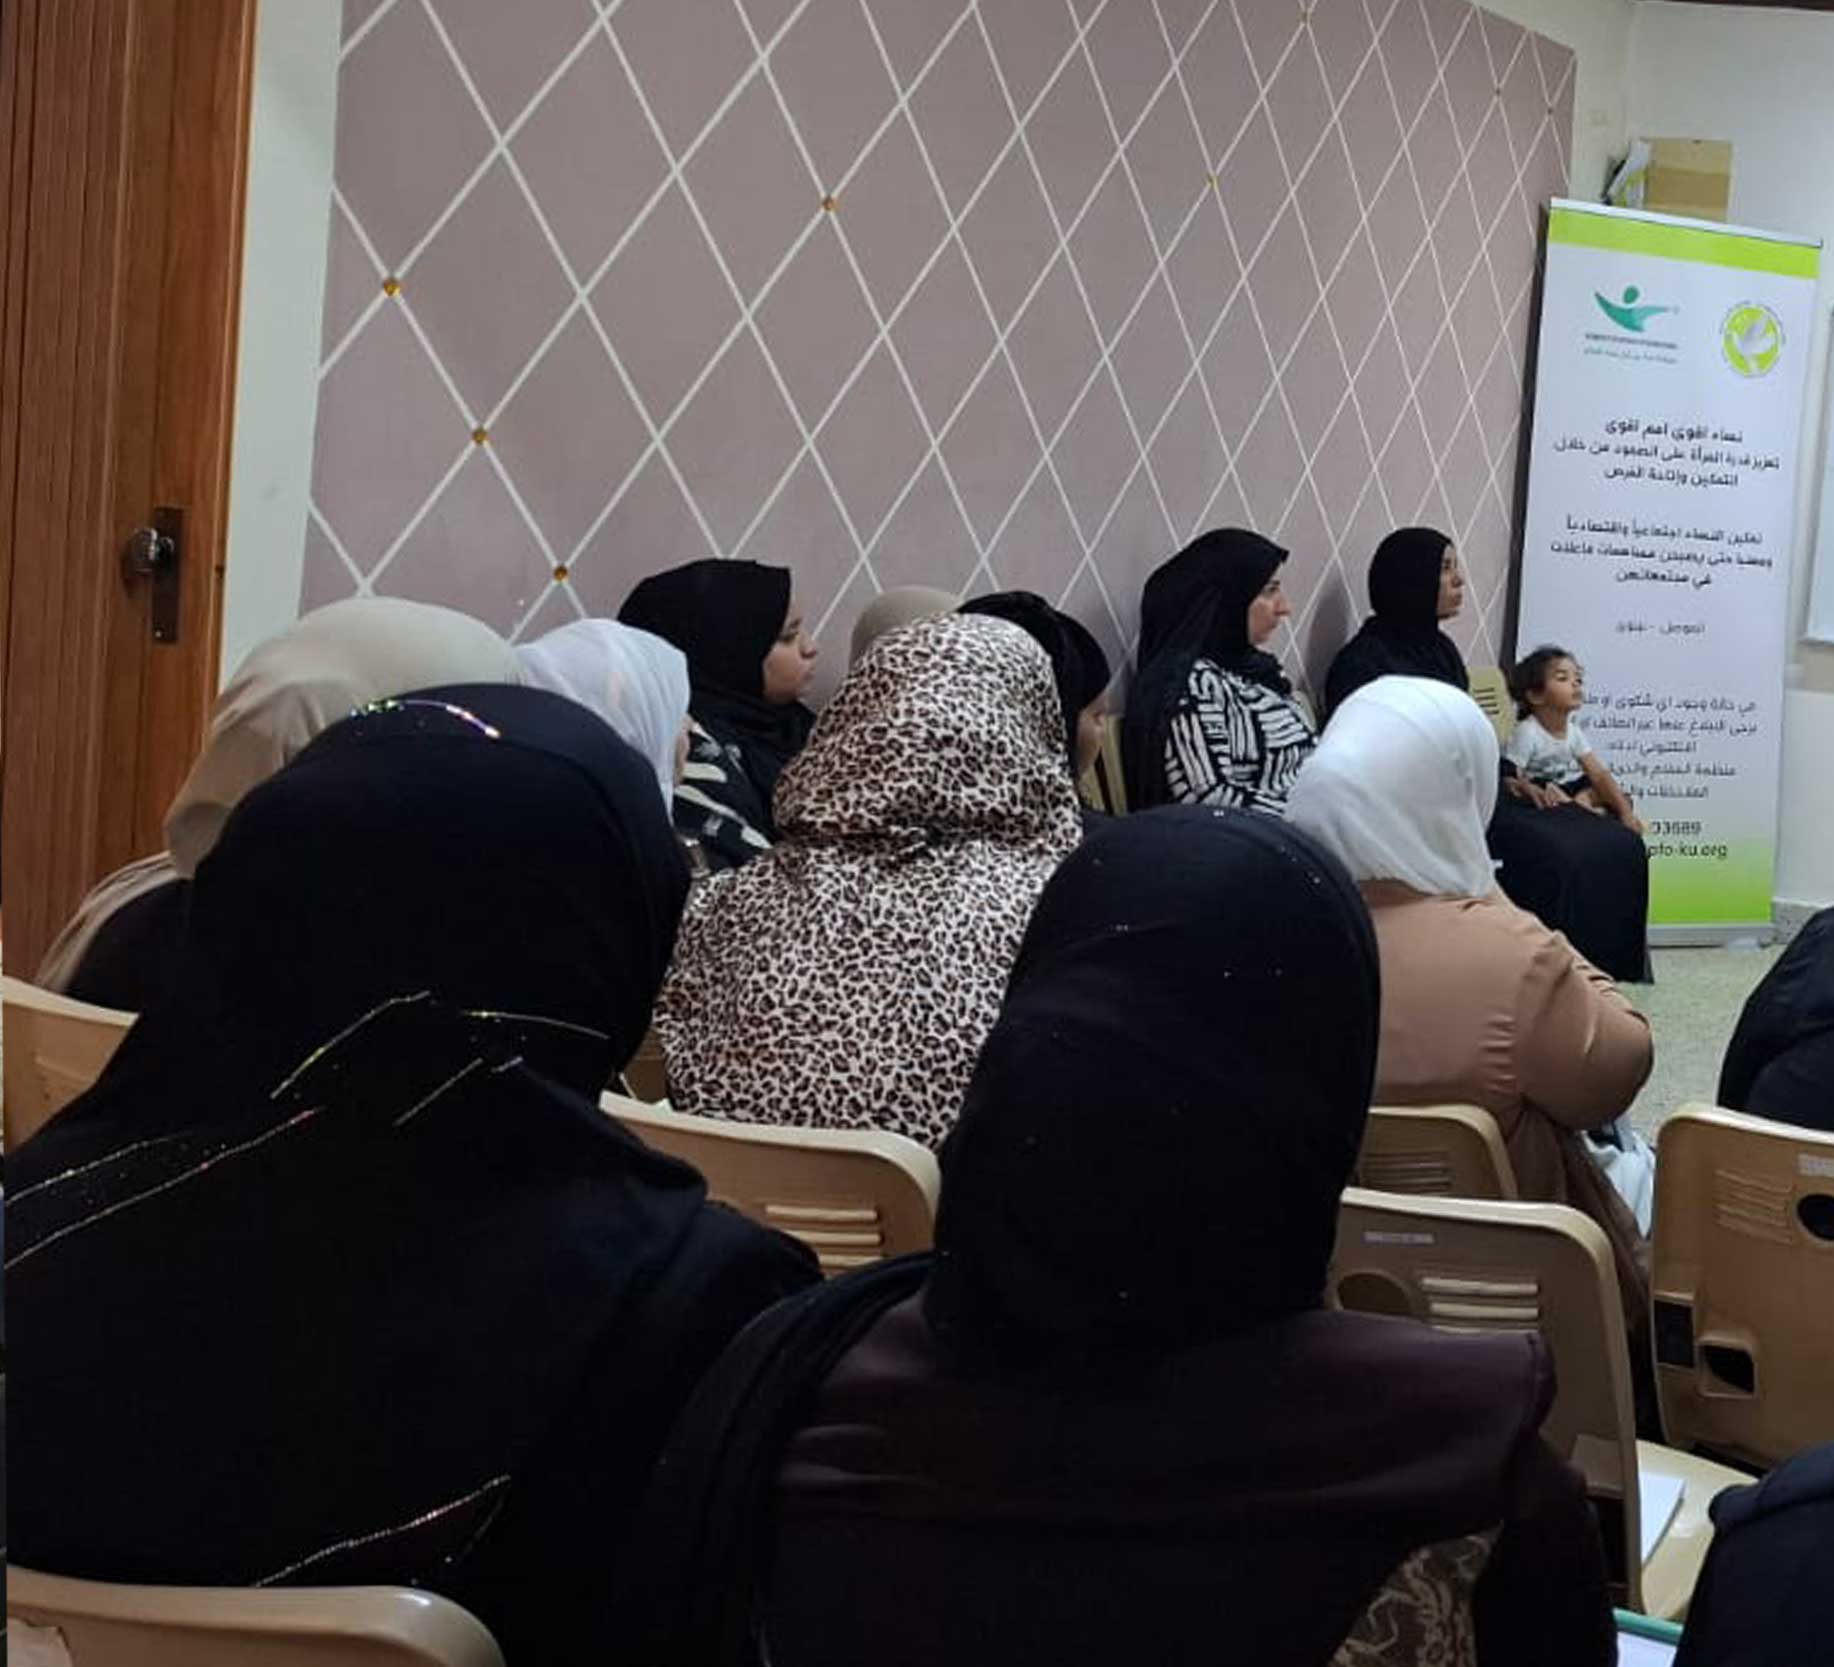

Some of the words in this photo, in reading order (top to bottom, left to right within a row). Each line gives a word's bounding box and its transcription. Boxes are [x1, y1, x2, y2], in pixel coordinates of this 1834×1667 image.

[1588, 441, 1610, 455] من
[1661, 446, 1684, 462] على
[1691, 572, 1713, 590] في
